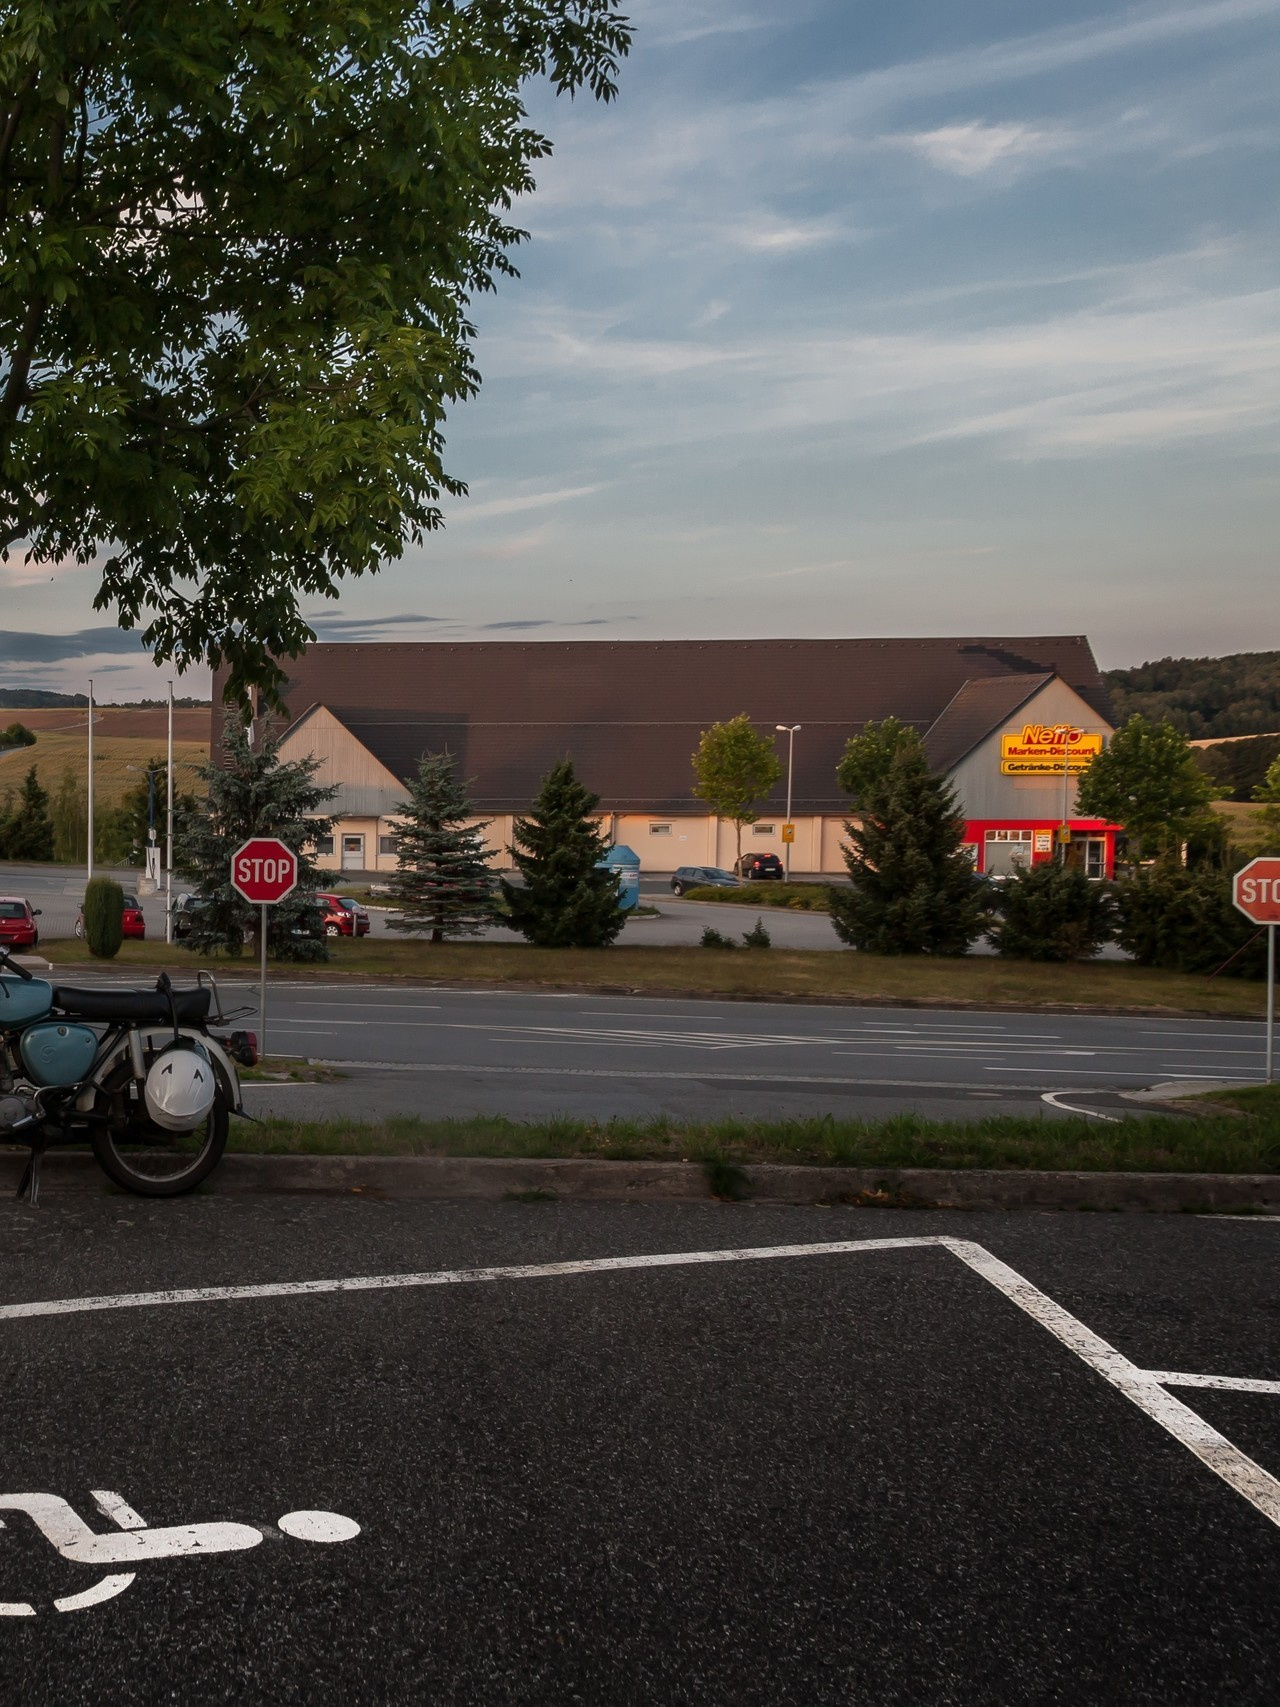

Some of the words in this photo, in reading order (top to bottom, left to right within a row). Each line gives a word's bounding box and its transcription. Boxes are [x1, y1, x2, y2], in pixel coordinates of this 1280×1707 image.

[1022, 724, 1083, 745] Netto
[1007, 746, 1095, 756] Marken-Discount
[238, 858, 291, 883] STOP
[1241, 878, 1280, 904] STO
